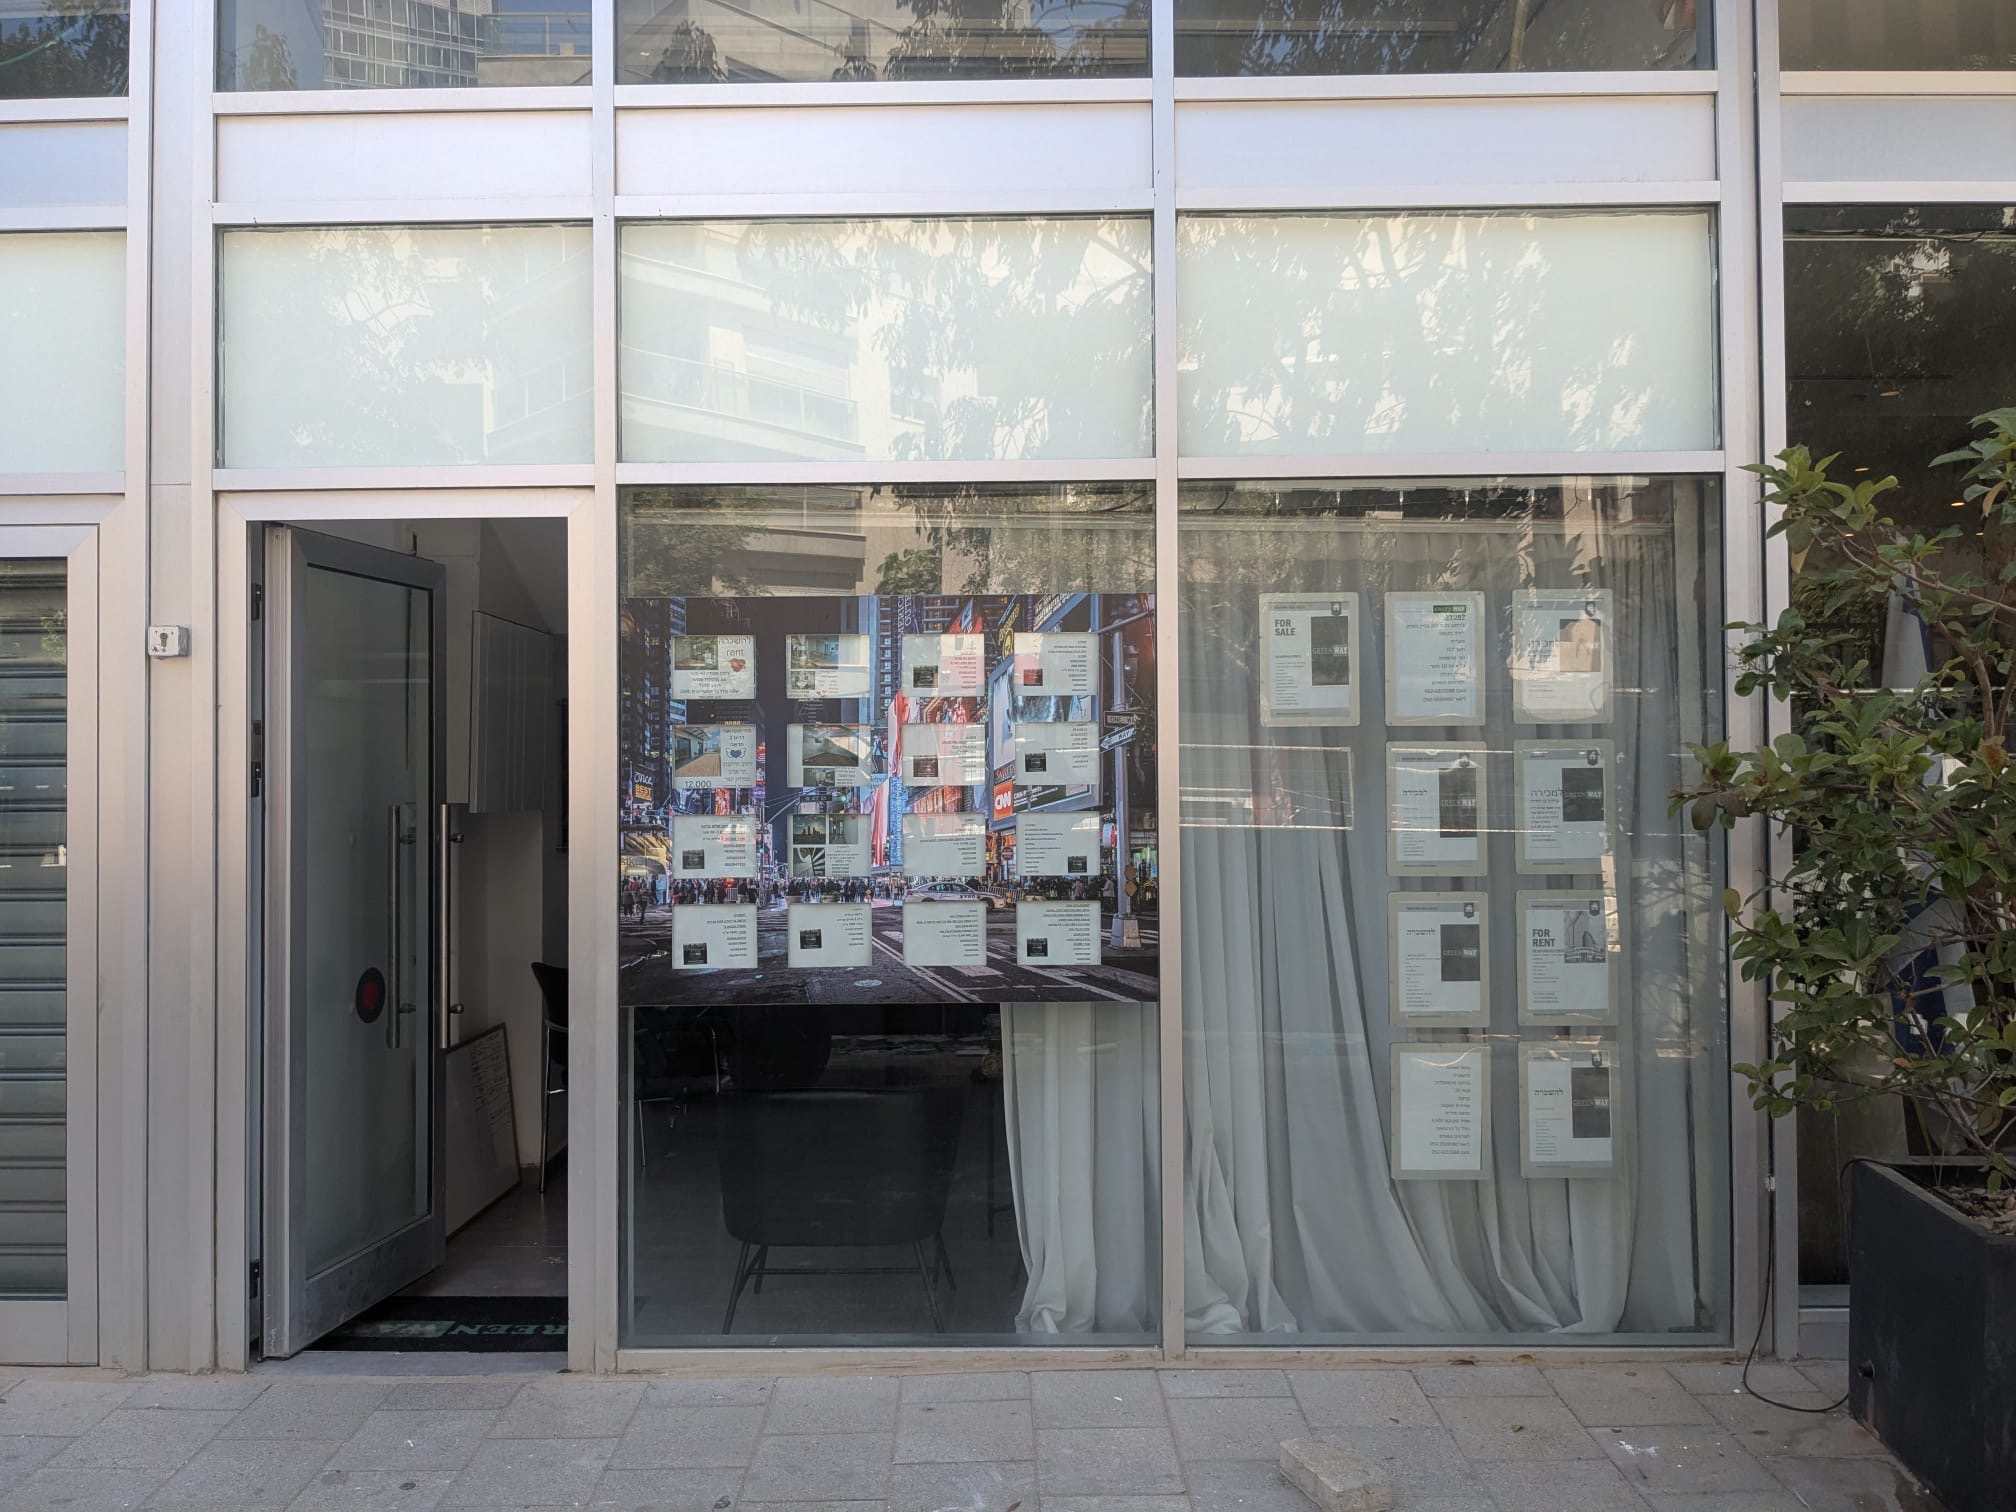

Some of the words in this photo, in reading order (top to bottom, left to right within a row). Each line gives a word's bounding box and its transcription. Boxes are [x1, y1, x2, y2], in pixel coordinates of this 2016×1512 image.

[1274, 619, 1292, 628] FOR
[1274, 627, 1296, 637] SALE
[726, 649, 745, 657] rent
[1333, 646, 1349, 655] WAY
[994, 790, 1012, 811] CNN
[1532, 929, 1550, 938] FOR
[1532, 938, 1556, 948] RENT
[447, 1324, 568, 1336] REEN
